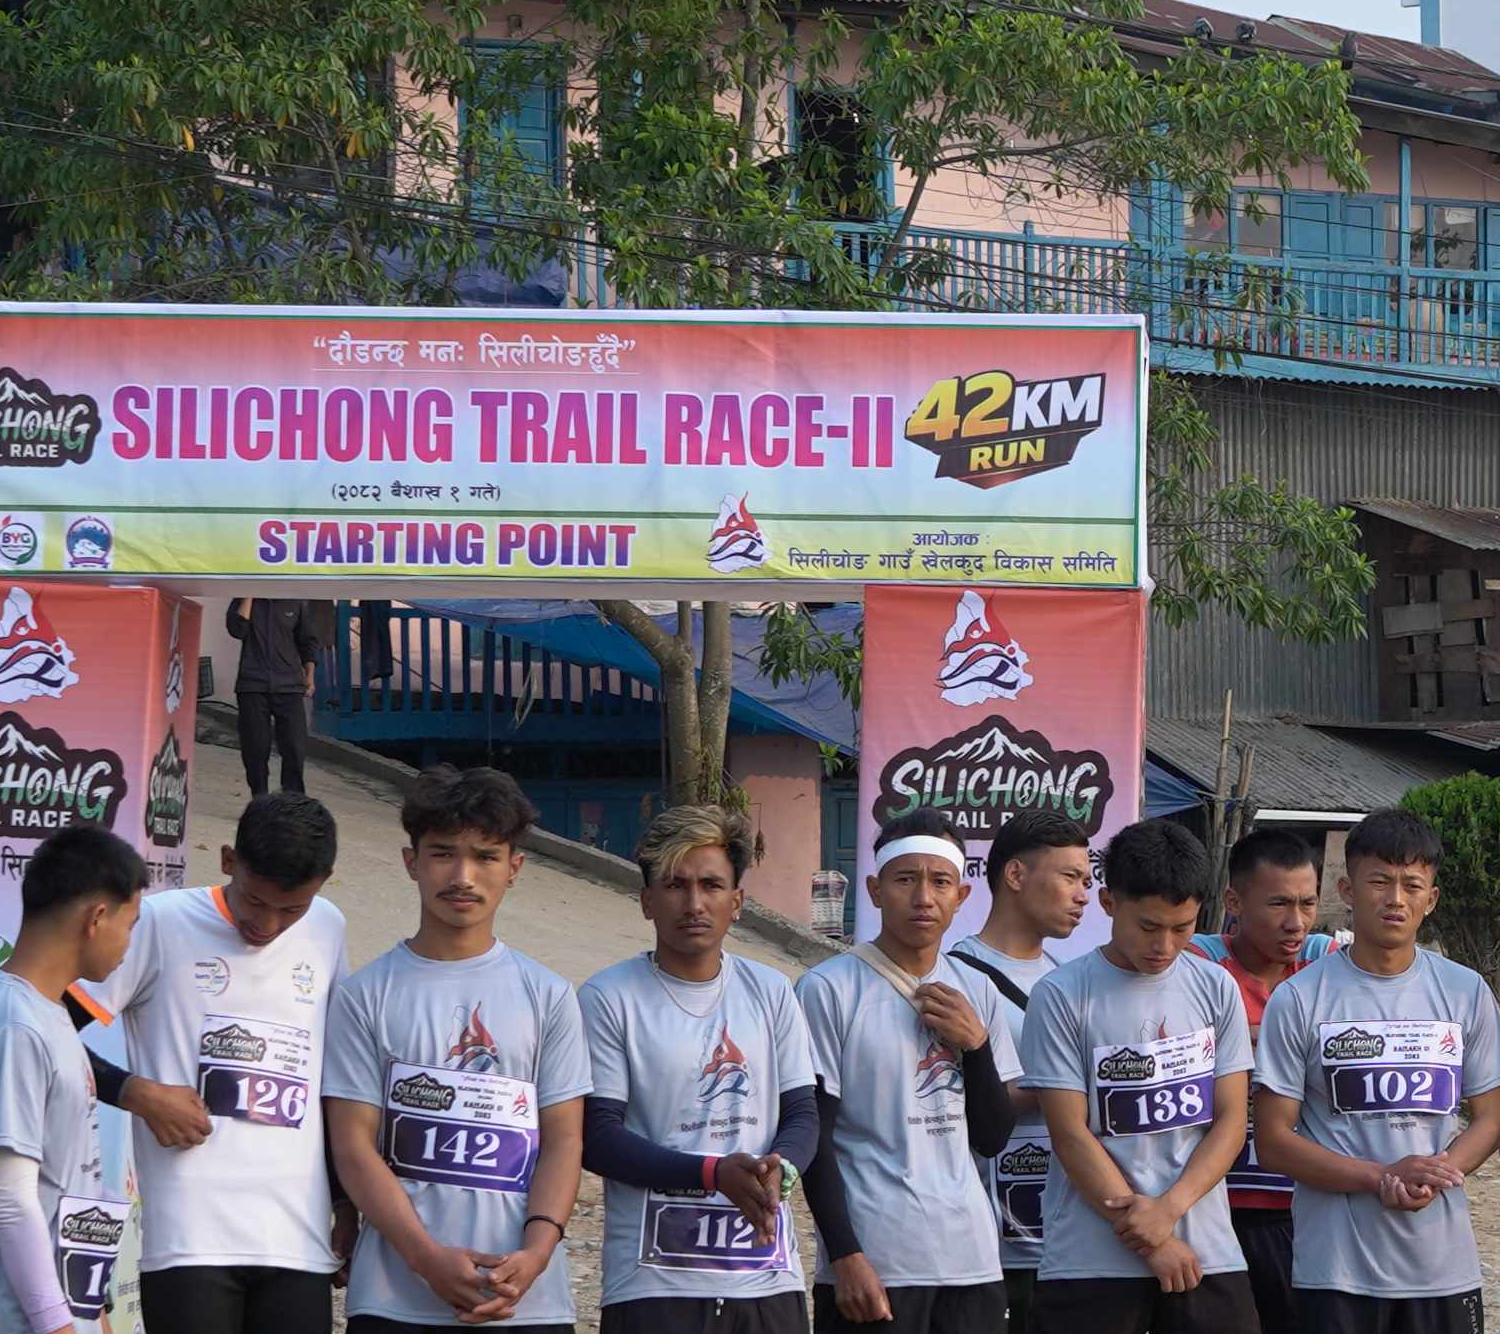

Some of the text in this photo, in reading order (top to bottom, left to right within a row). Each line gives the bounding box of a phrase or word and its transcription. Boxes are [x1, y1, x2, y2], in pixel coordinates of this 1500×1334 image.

[112, 384, 894, 468] SILICHONG TRAIL RACE-II
[9, 444, 60, 459] RACE
[969, 438, 1046, 472] RUN
[449, 484, 460, 503] १
[2, 532, 32, 544] BYG
[259, 520, 637, 567] STARTING POINT
[994, 549, 1053, 572] विकास
[1062, 550, 1117, 574] समिति
[887, 759, 1100, 825] SILICHONG
[11, 808, 72, 828] RACE
[235, 1077, 307, 1121] 126
[1363, 1070, 1433, 1103] 102
[1136, 1084, 1203, 1126] 138
[422, 1126, 500, 1167] 142
[1003, 1154, 1049, 1172] SILICHON
[695, 1214, 755, 1249] 112
